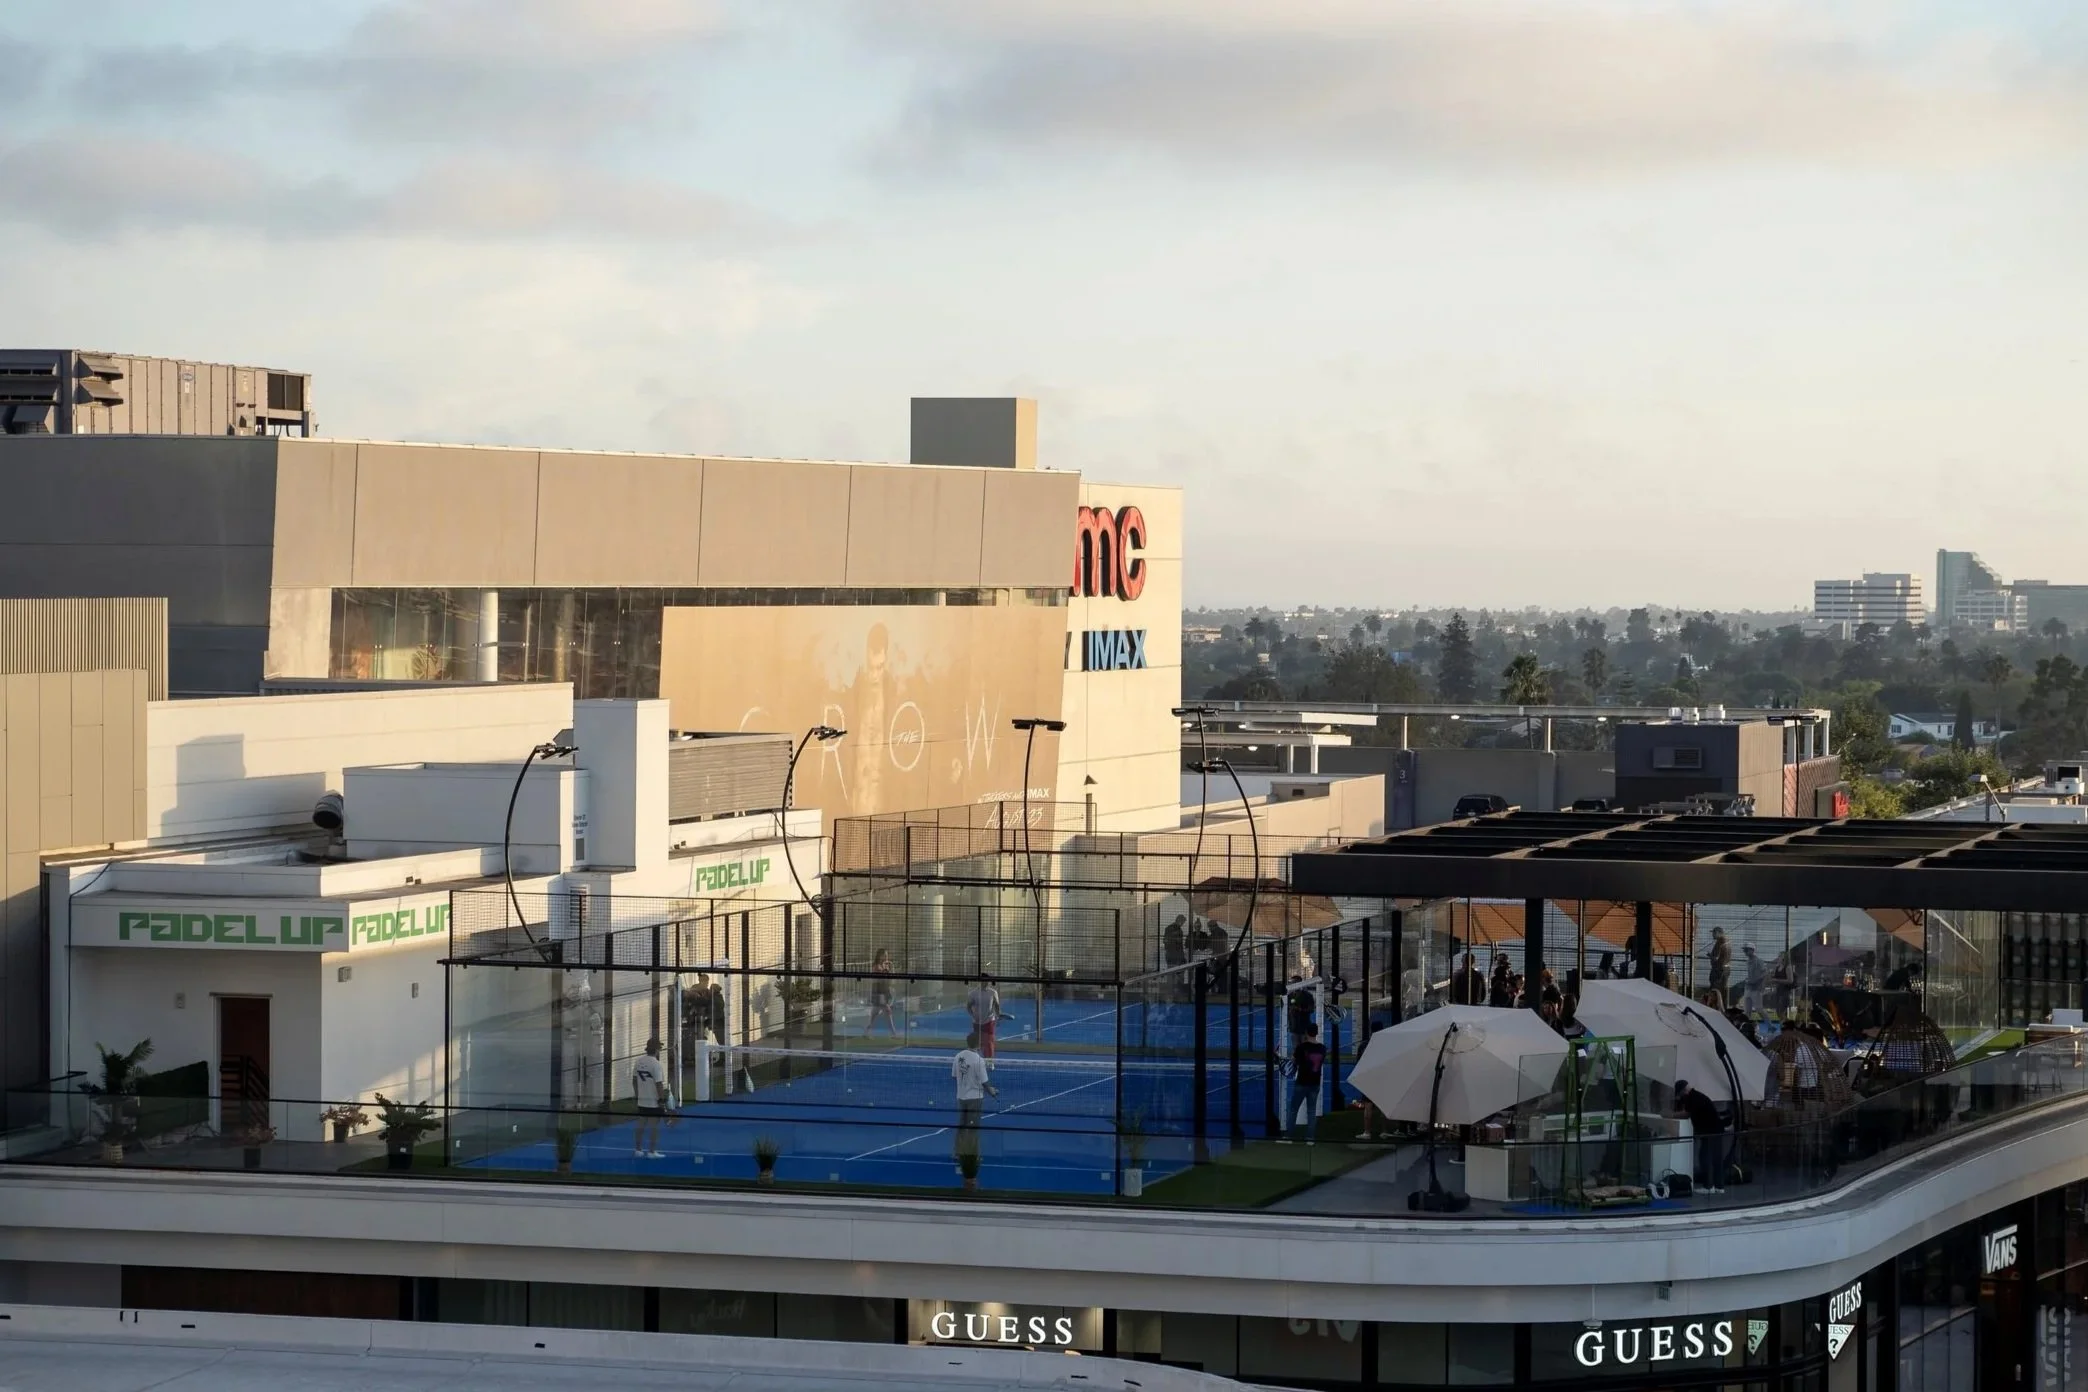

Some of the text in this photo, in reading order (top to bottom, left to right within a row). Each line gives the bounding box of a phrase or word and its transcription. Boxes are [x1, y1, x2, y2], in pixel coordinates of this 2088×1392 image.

[1085, 629, 1147, 671] IMAX
[1027, 787, 1050, 799] IMAX
[749, 858, 771, 885] UP
[280, 916, 343, 945] UP
[1984, 1224, 2018, 1274] VANS
[1828, 1281, 1862, 1323] GUESS
[930, 1312, 1073, 1344] GUESS
[1575, 1320, 1733, 1367] GUESS
